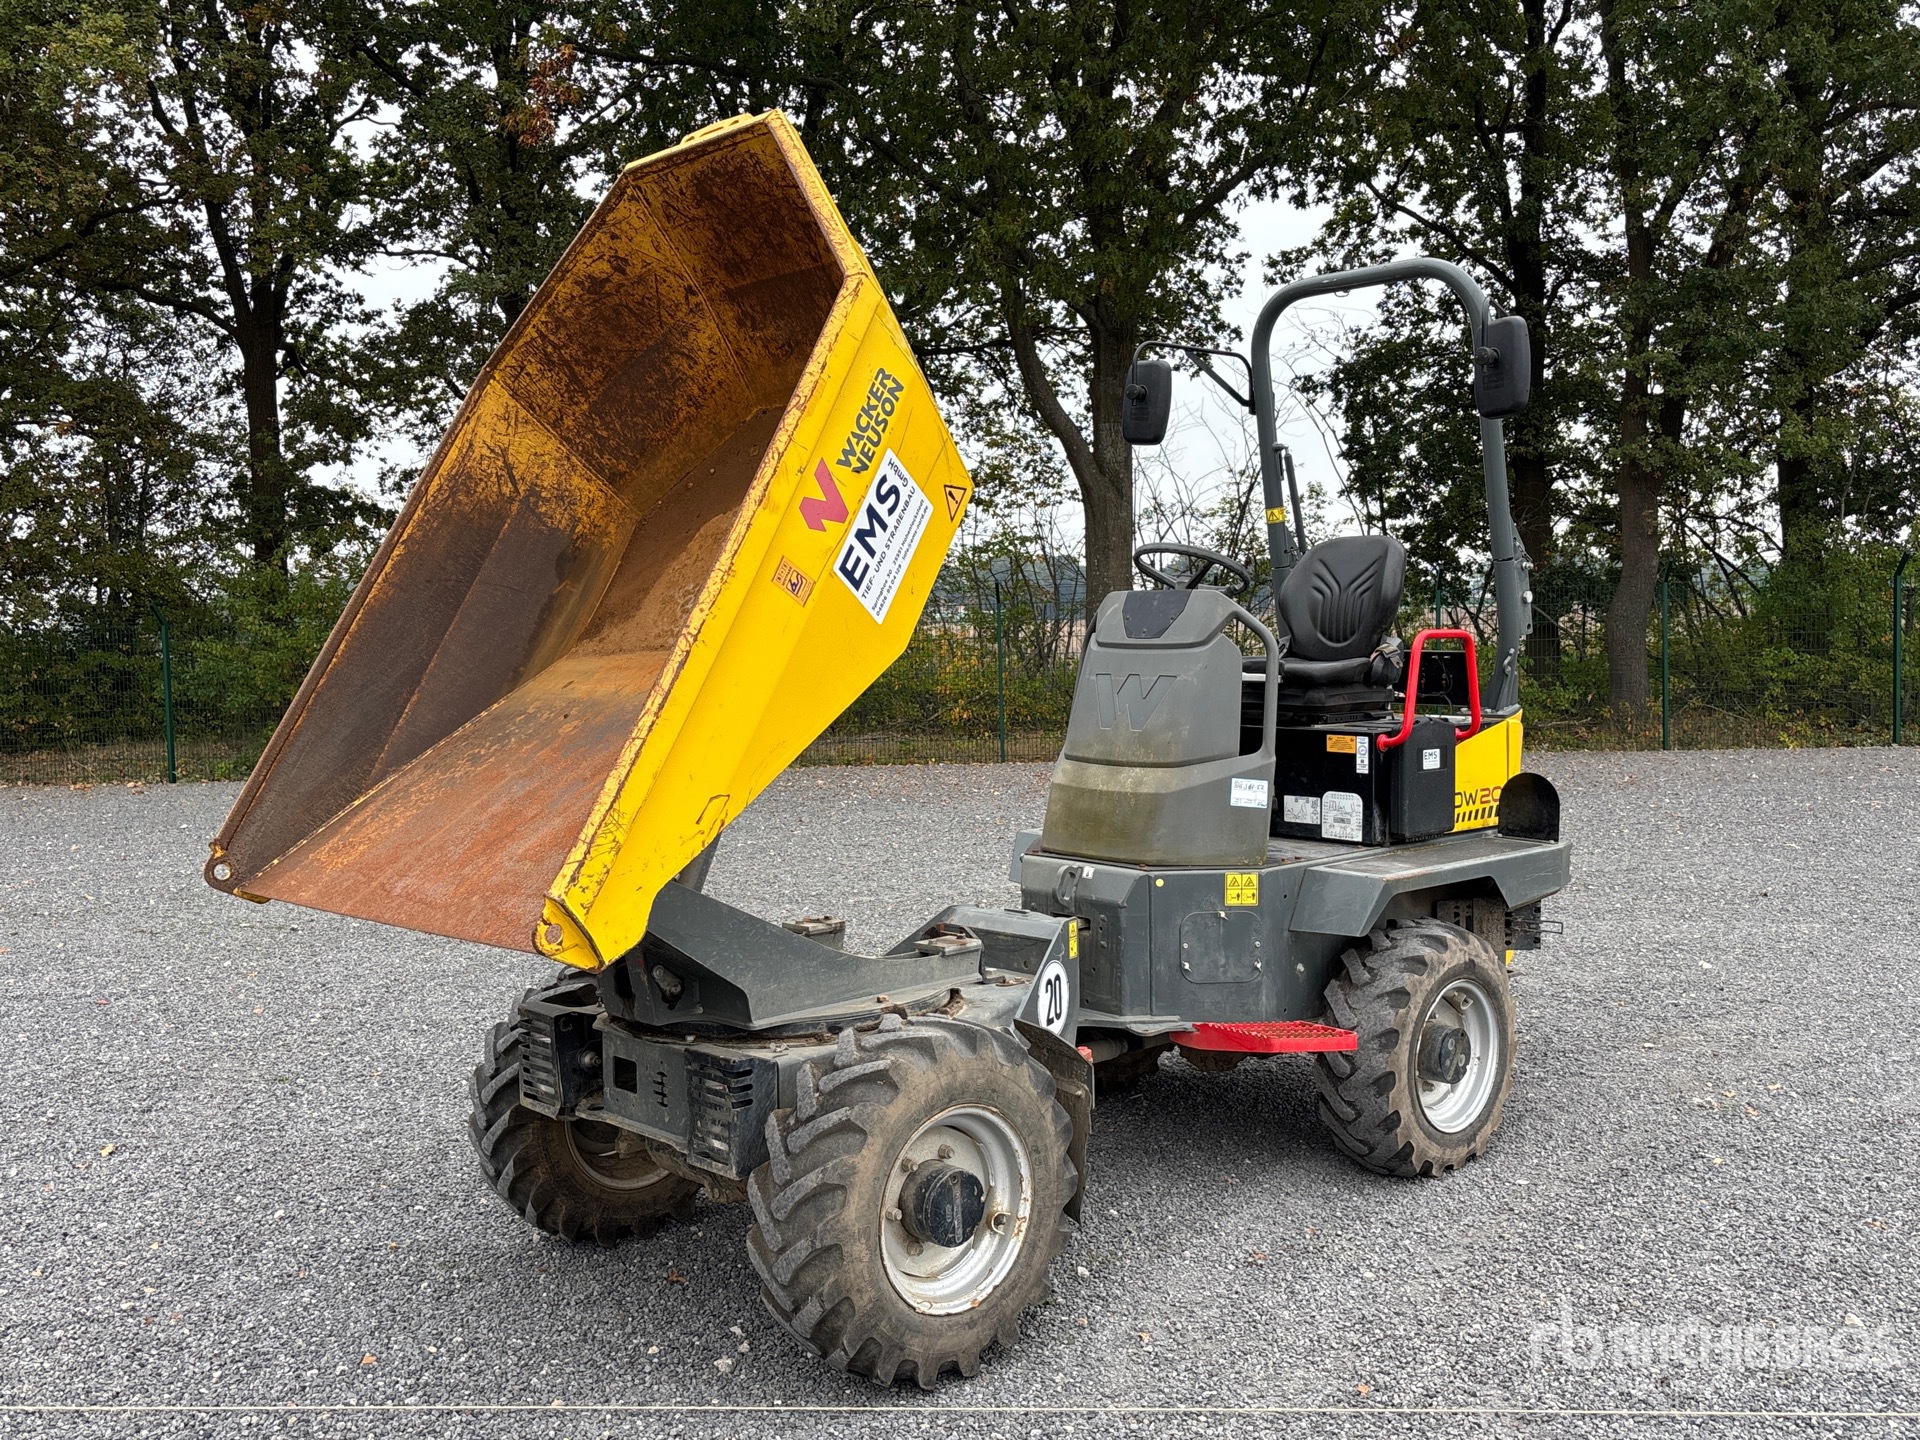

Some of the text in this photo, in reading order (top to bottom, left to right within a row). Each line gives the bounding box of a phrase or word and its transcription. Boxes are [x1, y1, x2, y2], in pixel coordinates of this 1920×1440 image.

[836, 368, 892, 468] WACKER
[851, 376, 904, 474] NEUSON
[887, 458, 909, 488] GmbH
[838, 473, 901, 592] EMS
[861, 573, 876, 601] TIEF-
[873, 549, 887, 574] UND
[1424, 751, 1438, 760] EMS
[1045, 973, 1062, 1026] 20
